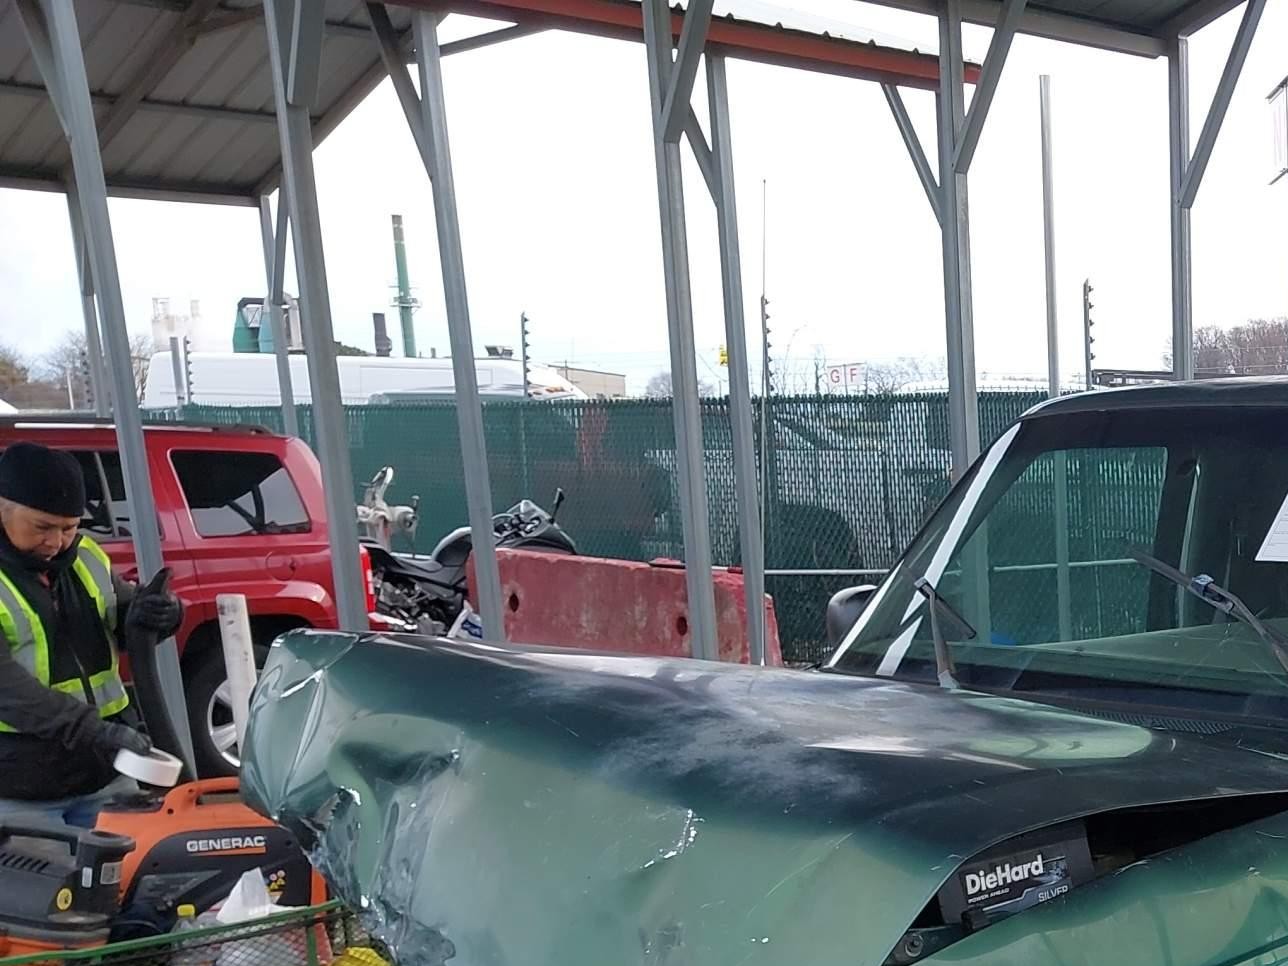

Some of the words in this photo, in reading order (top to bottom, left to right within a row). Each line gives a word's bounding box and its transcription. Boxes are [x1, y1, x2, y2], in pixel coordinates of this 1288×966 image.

[830, 369, 840, 383] G
[850, 368, 857, 382] F
[186, 836, 266, 852] GENERAC
[965, 854, 1043, 895] DieHard
